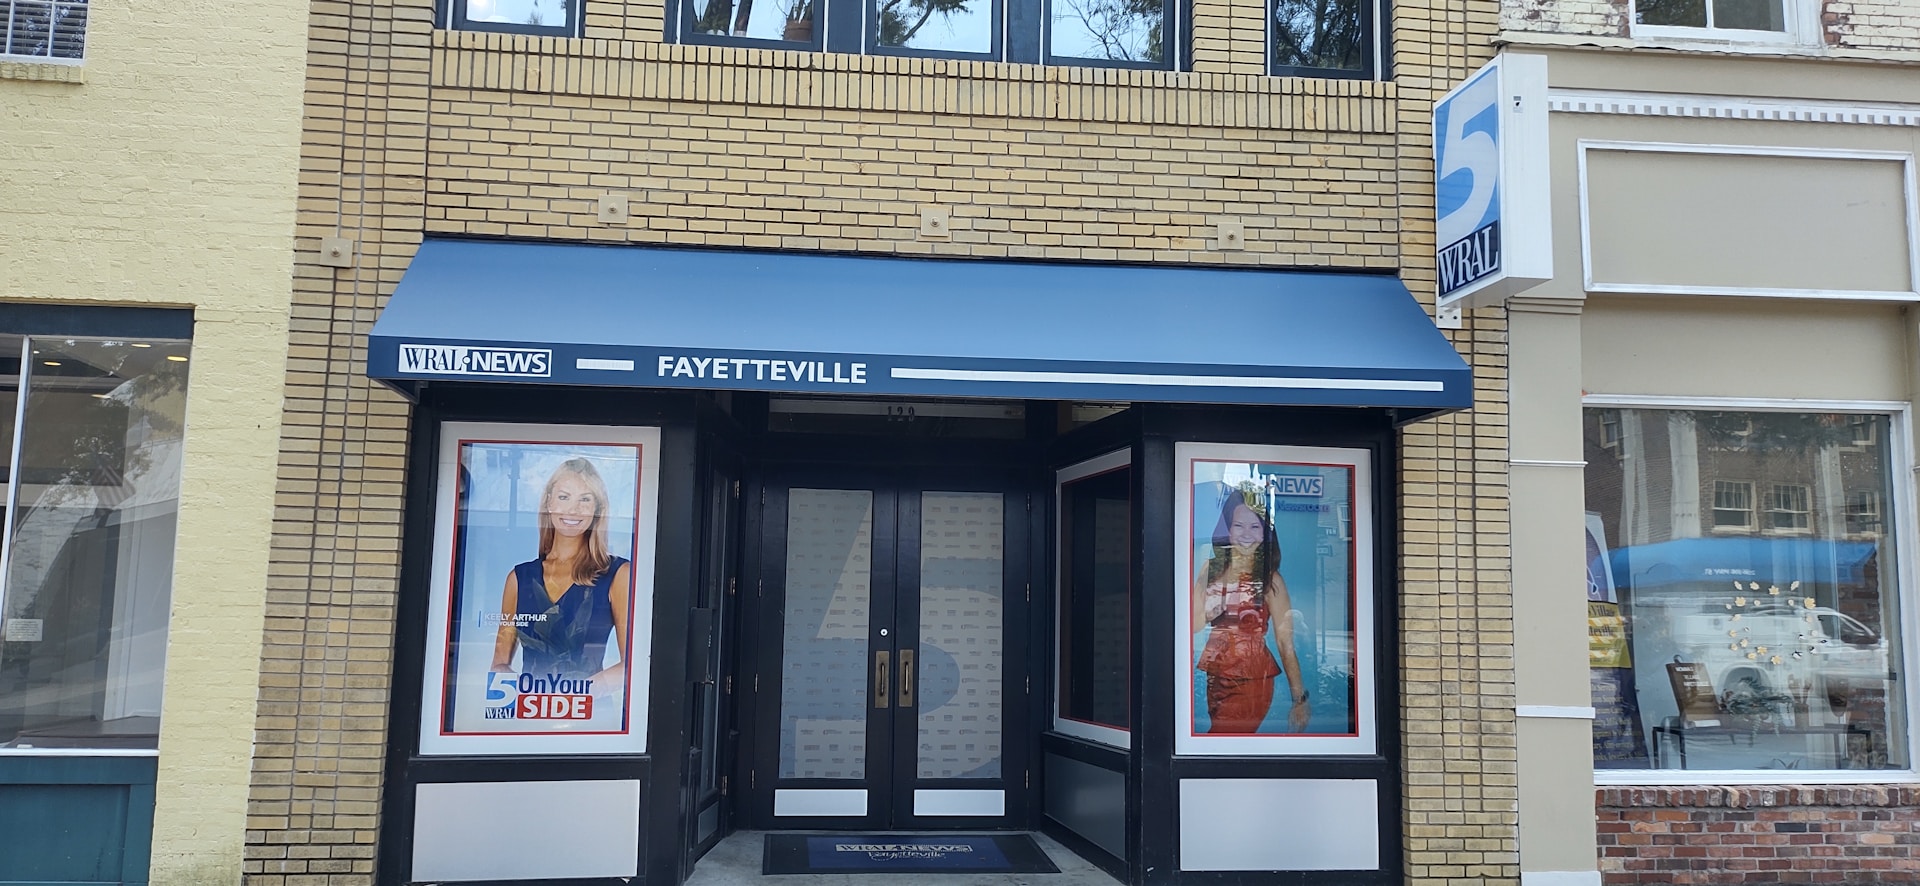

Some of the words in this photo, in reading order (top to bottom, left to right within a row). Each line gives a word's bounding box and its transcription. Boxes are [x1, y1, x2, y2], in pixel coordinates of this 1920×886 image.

[1438, 66, 1498, 250] 5
[1438, 226, 1499, 293] WRAL
[404, 347, 463, 371] WRAL
[471, 351, 547, 374] NEWS
[657, 355, 867, 384] FAYETTEVILLE
[1271, 477, 1321, 494] NEWS
[484, 613, 511, 621] KEELY
[511, 613, 548, 622] ARTHUR
[484, 672, 518, 708] 5
[485, 707, 515, 719] WRAL
[522, 695, 588, 719] SIDE
